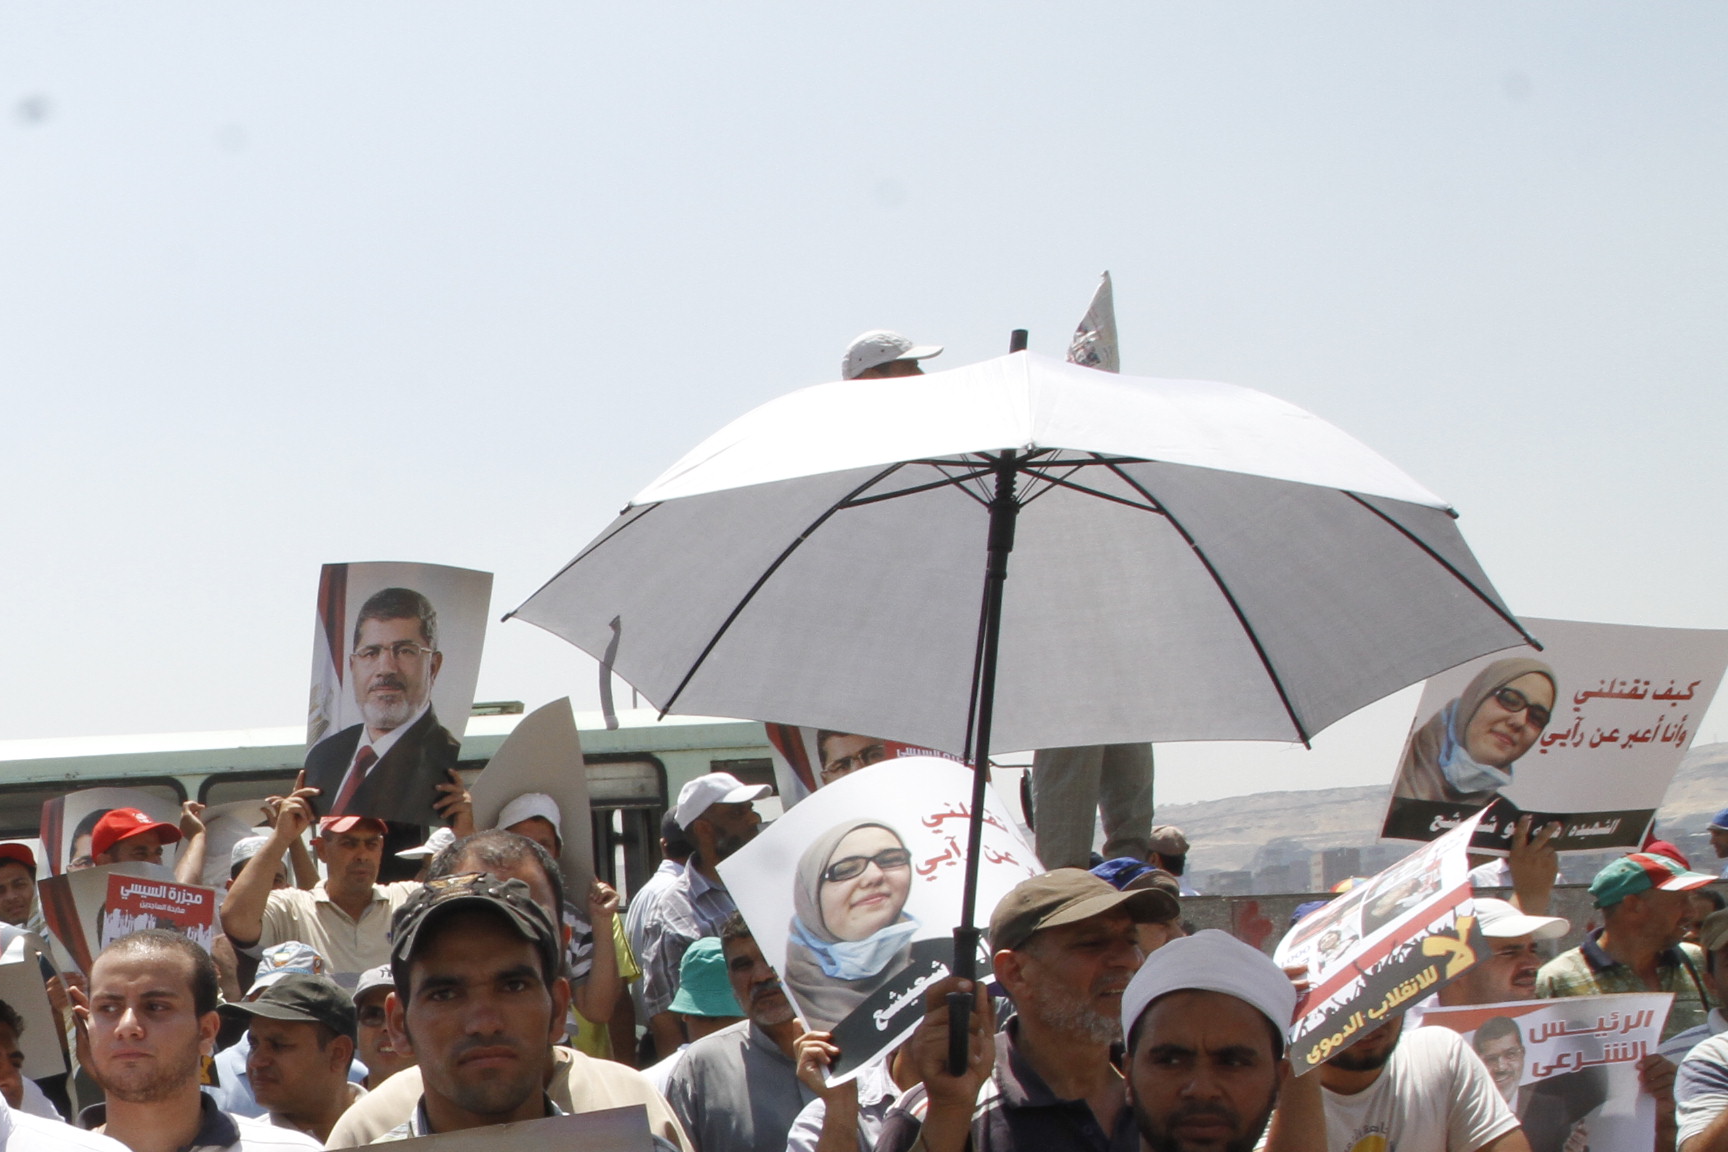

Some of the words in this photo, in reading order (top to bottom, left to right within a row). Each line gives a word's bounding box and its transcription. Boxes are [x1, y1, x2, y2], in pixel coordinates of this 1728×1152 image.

[1573, 677, 1649, 711] تقتلني
[1653, 680, 1702, 707] كيف
[1589, 727, 1620, 748] عن
[1620, 714, 1663, 749] أعبر
[1660, 714, 1689, 748] وأنا
[120, 883, 166, 900] السيسي
[168, 887, 202, 906] مجزرة
[1422, 916, 1478, 979] لا
[1368, 965, 1440, 1020] للانقلاب
[1529, 1009, 1655, 1044] الرئيس
